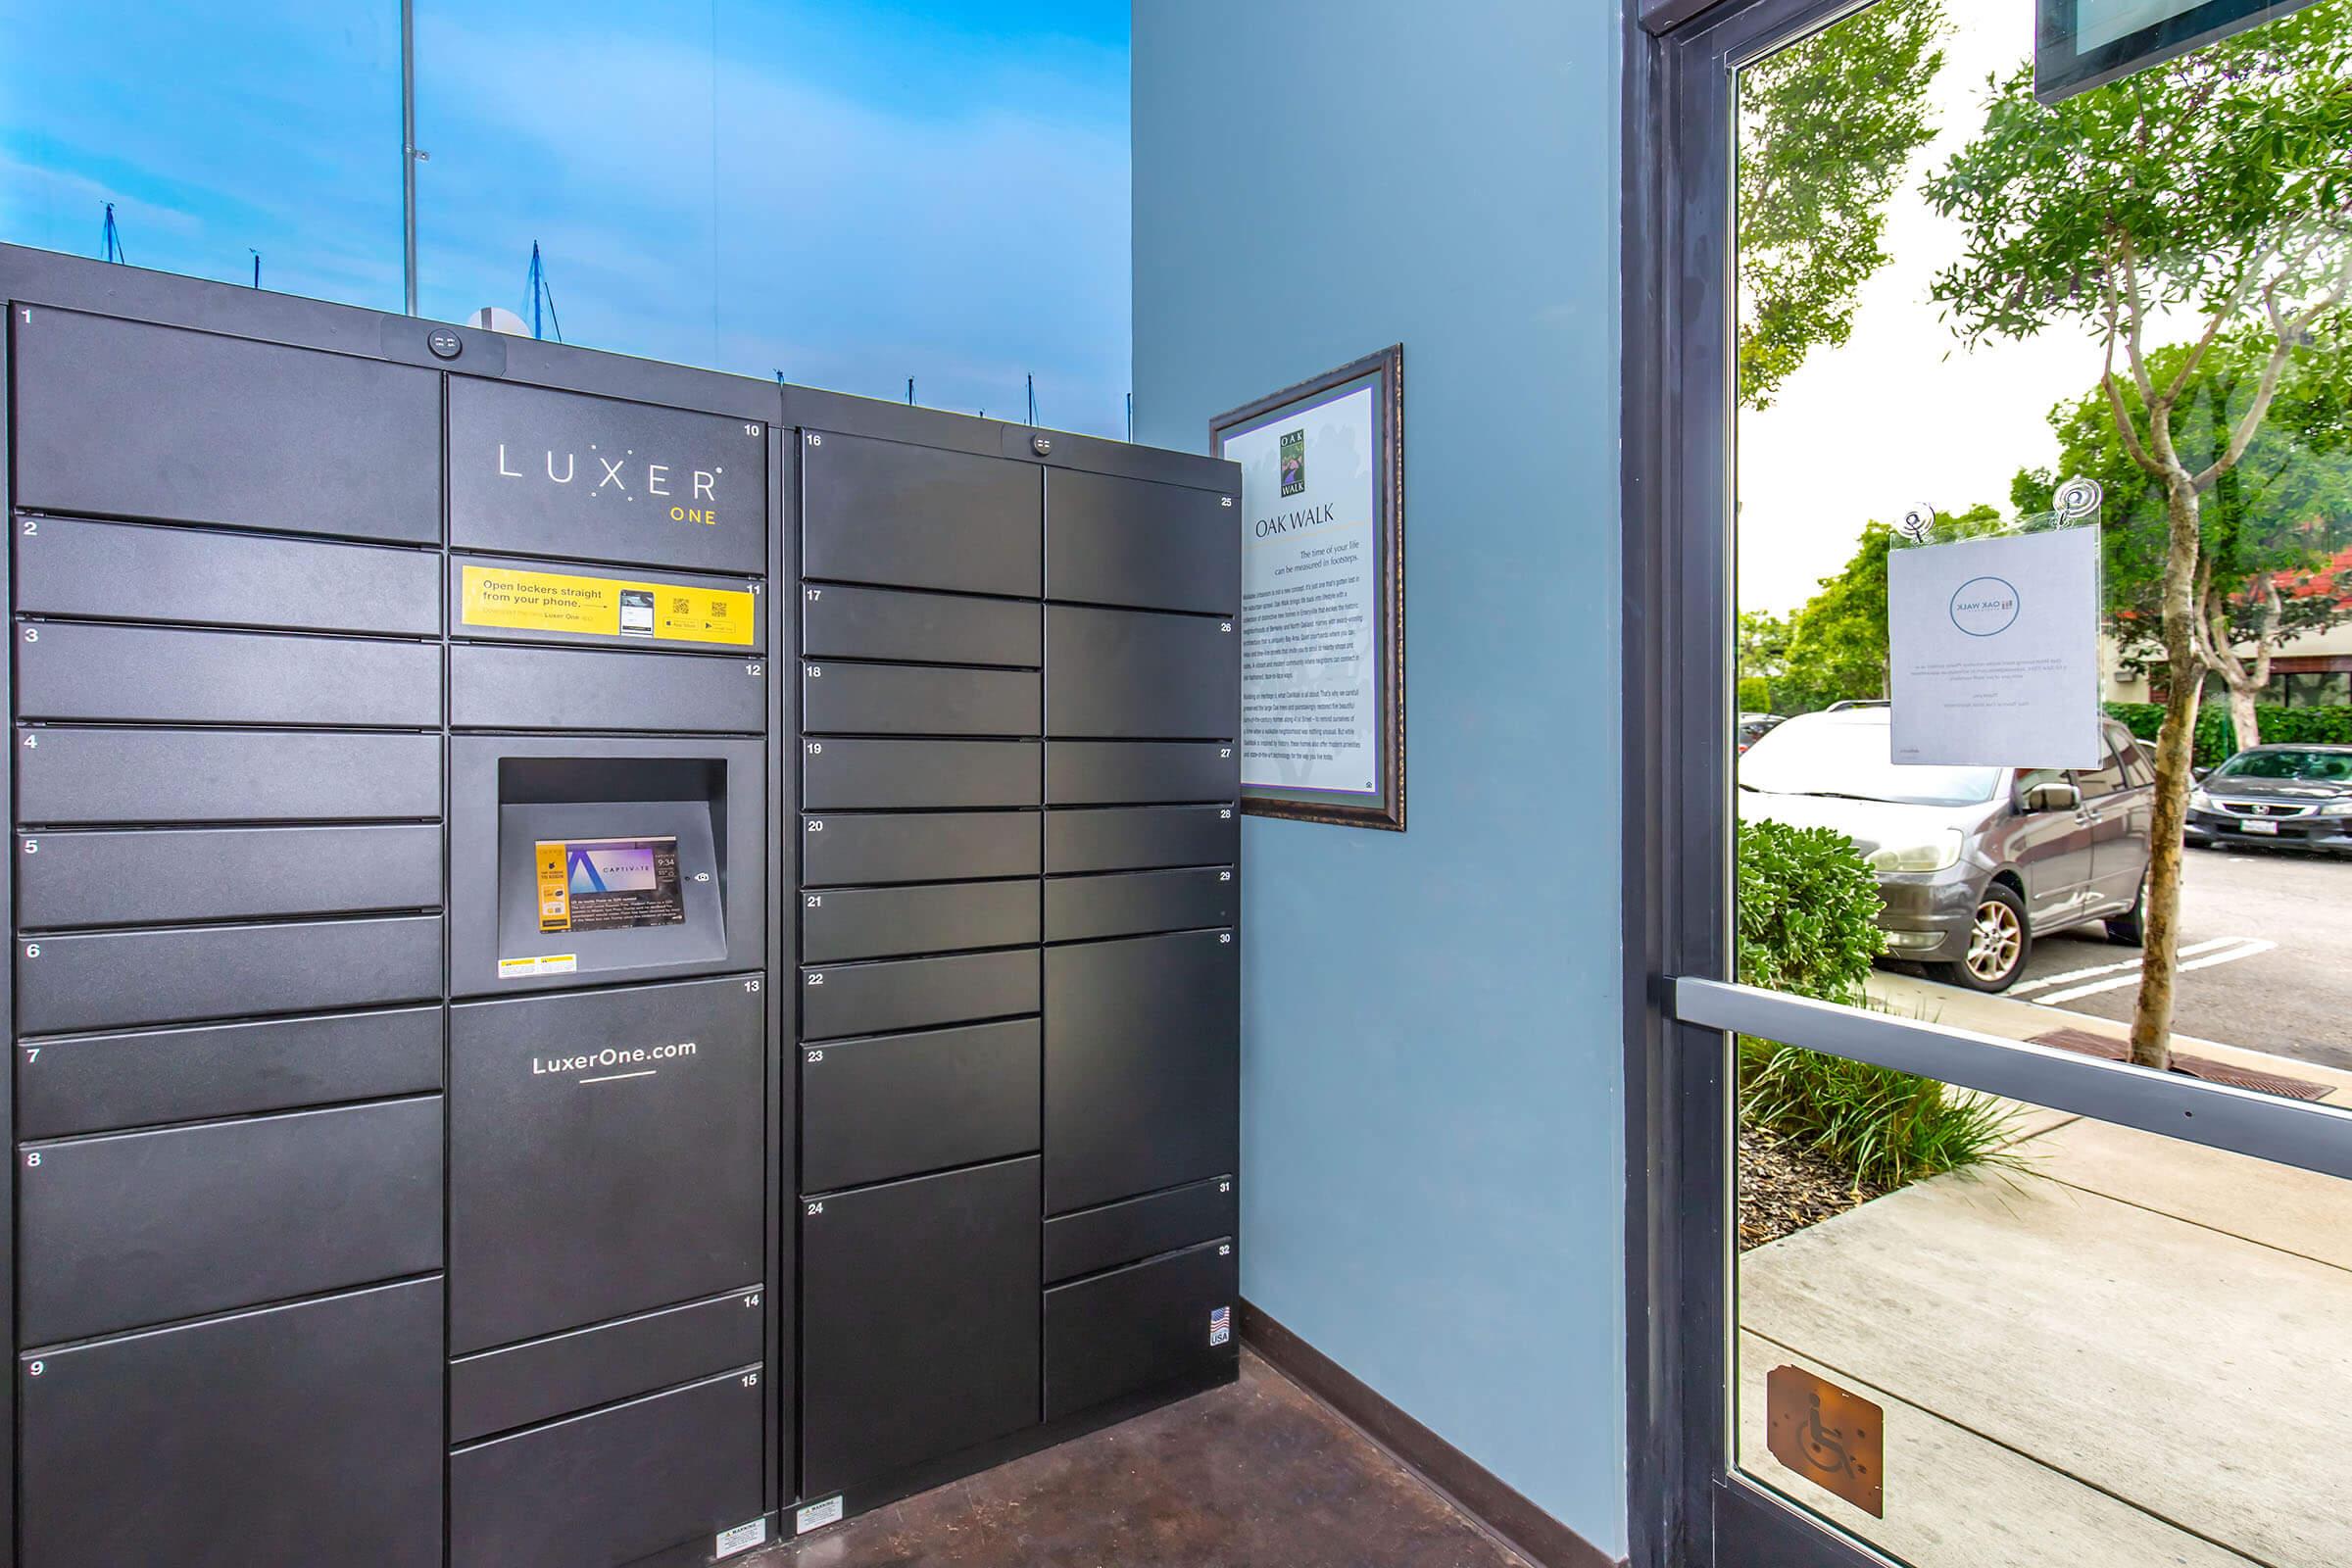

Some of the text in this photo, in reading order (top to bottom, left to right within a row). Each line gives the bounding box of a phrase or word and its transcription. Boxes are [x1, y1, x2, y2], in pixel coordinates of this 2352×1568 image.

[23, 310, 30, 322] 1
[745, 425, 759, 436] 10
[808, 435, 821, 446] 16
[1281, 432, 1302, 446] OAK
[500, 444, 716, 501] LUXER
[1283, 482, 1303, 495] WALK
[1221, 497, 1232, 507] 25
[670, 507, 715, 525] ONE
[1255, 503, 1334, 538] OAK WALK
[24, 522, 36, 535] 2
[1300, 550, 1310, 559] The
[1312, 548, 1325, 558] time
[1326, 545, 1333, 555] of
[1334, 544, 1348, 555] your
[1275, 566, 1285, 575] can
[1286, 564, 1293, 573] be
[1295, 559, 1322, 571] measured
[483, 579, 602, 599] Open lockers straight
[747, 585, 760, 595] 11
[808, 590, 820, 600] 17
[483, 592, 581, 608] from your phone.
[1221, 622, 1232, 632] 26
[25, 629, 38, 642] 3
[746, 665, 760, 675] 12
[808, 666, 821, 677] 18
[24, 735, 37, 748] 4
[808, 743, 821, 754] 19
[1220, 748, 1232, 759] 27
[1220, 808, 1231, 819] 28
[808, 821, 822, 831] 20
[25, 840, 37, 853] 5
[1220, 871, 1231, 881] 29
[808, 897, 820, 906] 21
[1219, 933, 1231, 944] 30
[26, 944, 40, 957] 6
[808, 974, 822, 984] 22
[745, 981, 760, 992] 13
[27, 1049, 39, 1062] 7
[533, 1041, 697, 1075] LuxerOne.com
[808, 1051, 822, 1061] 23
[27, 1153, 40, 1166] 8
[1219, 1182, 1230, 1193] 31
[808, 1202, 823, 1215] 24
[1219, 1245, 1230, 1255] 32
[744, 1295, 759, 1307] 14
[1211, 1332, 1228, 1346] USA
[31, 1361, 43, 1375] 9
[742, 1374, 757, 1387] 15
